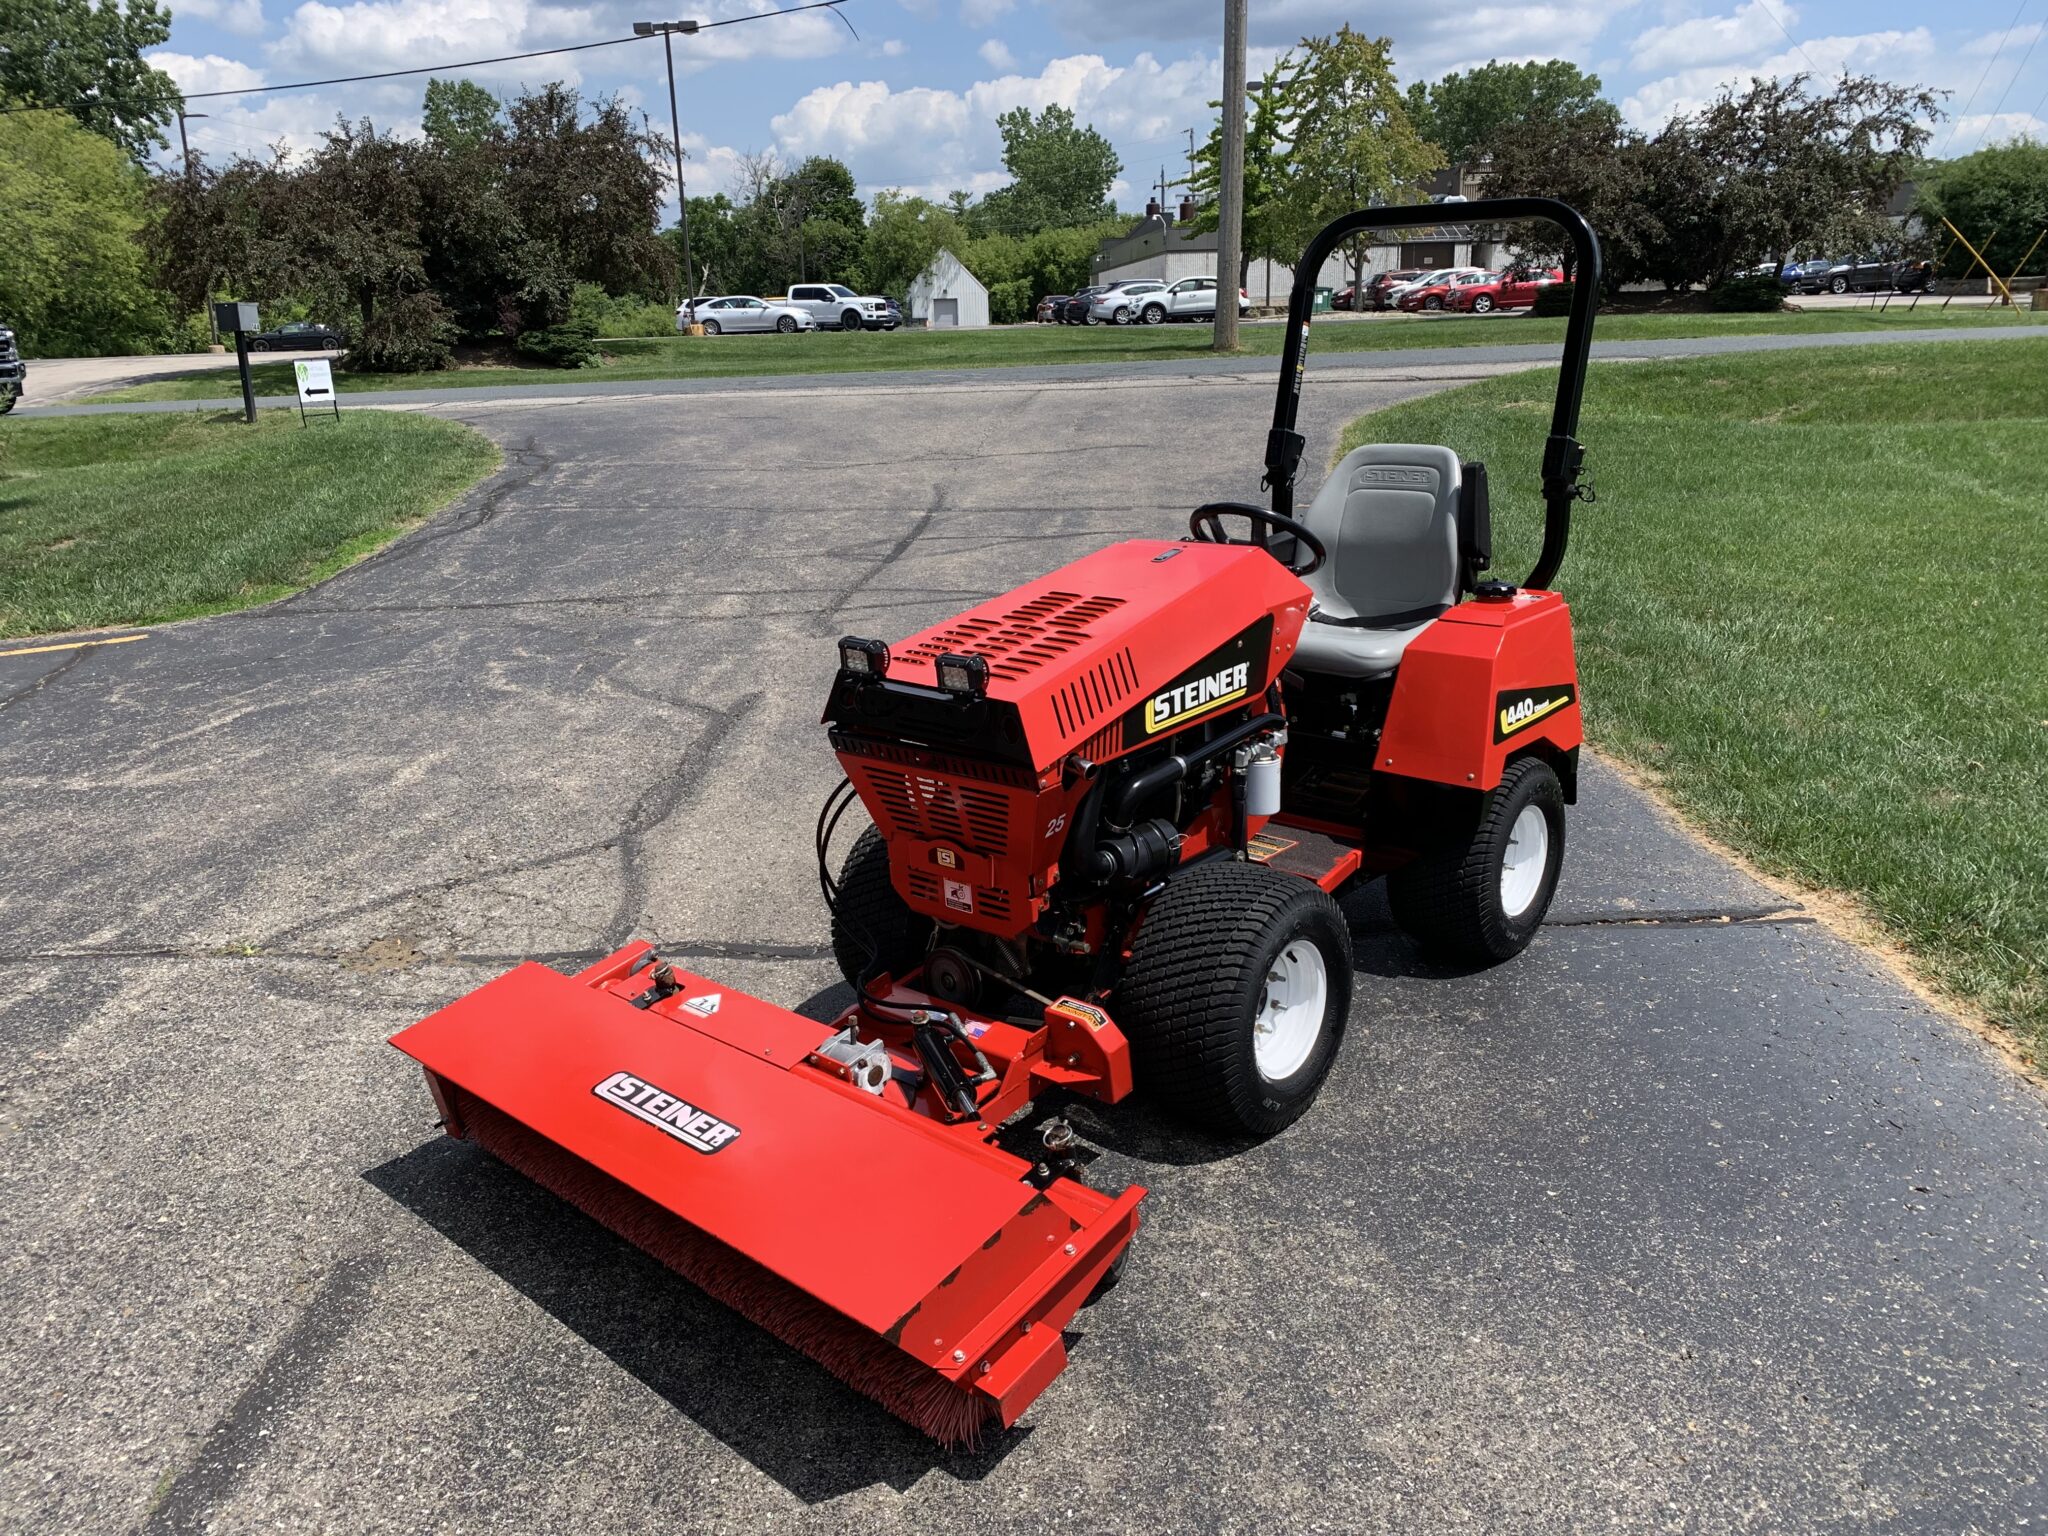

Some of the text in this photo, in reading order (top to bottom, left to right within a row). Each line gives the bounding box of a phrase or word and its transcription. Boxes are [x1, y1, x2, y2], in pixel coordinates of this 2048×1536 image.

[1154, 662, 1248, 722] STEINER
[1507, 698, 1533, 723] 440
[1045, 813, 1066, 838] 25
[941, 852, 951, 863] S
[609, 1077, 736, 1147] STEINER
